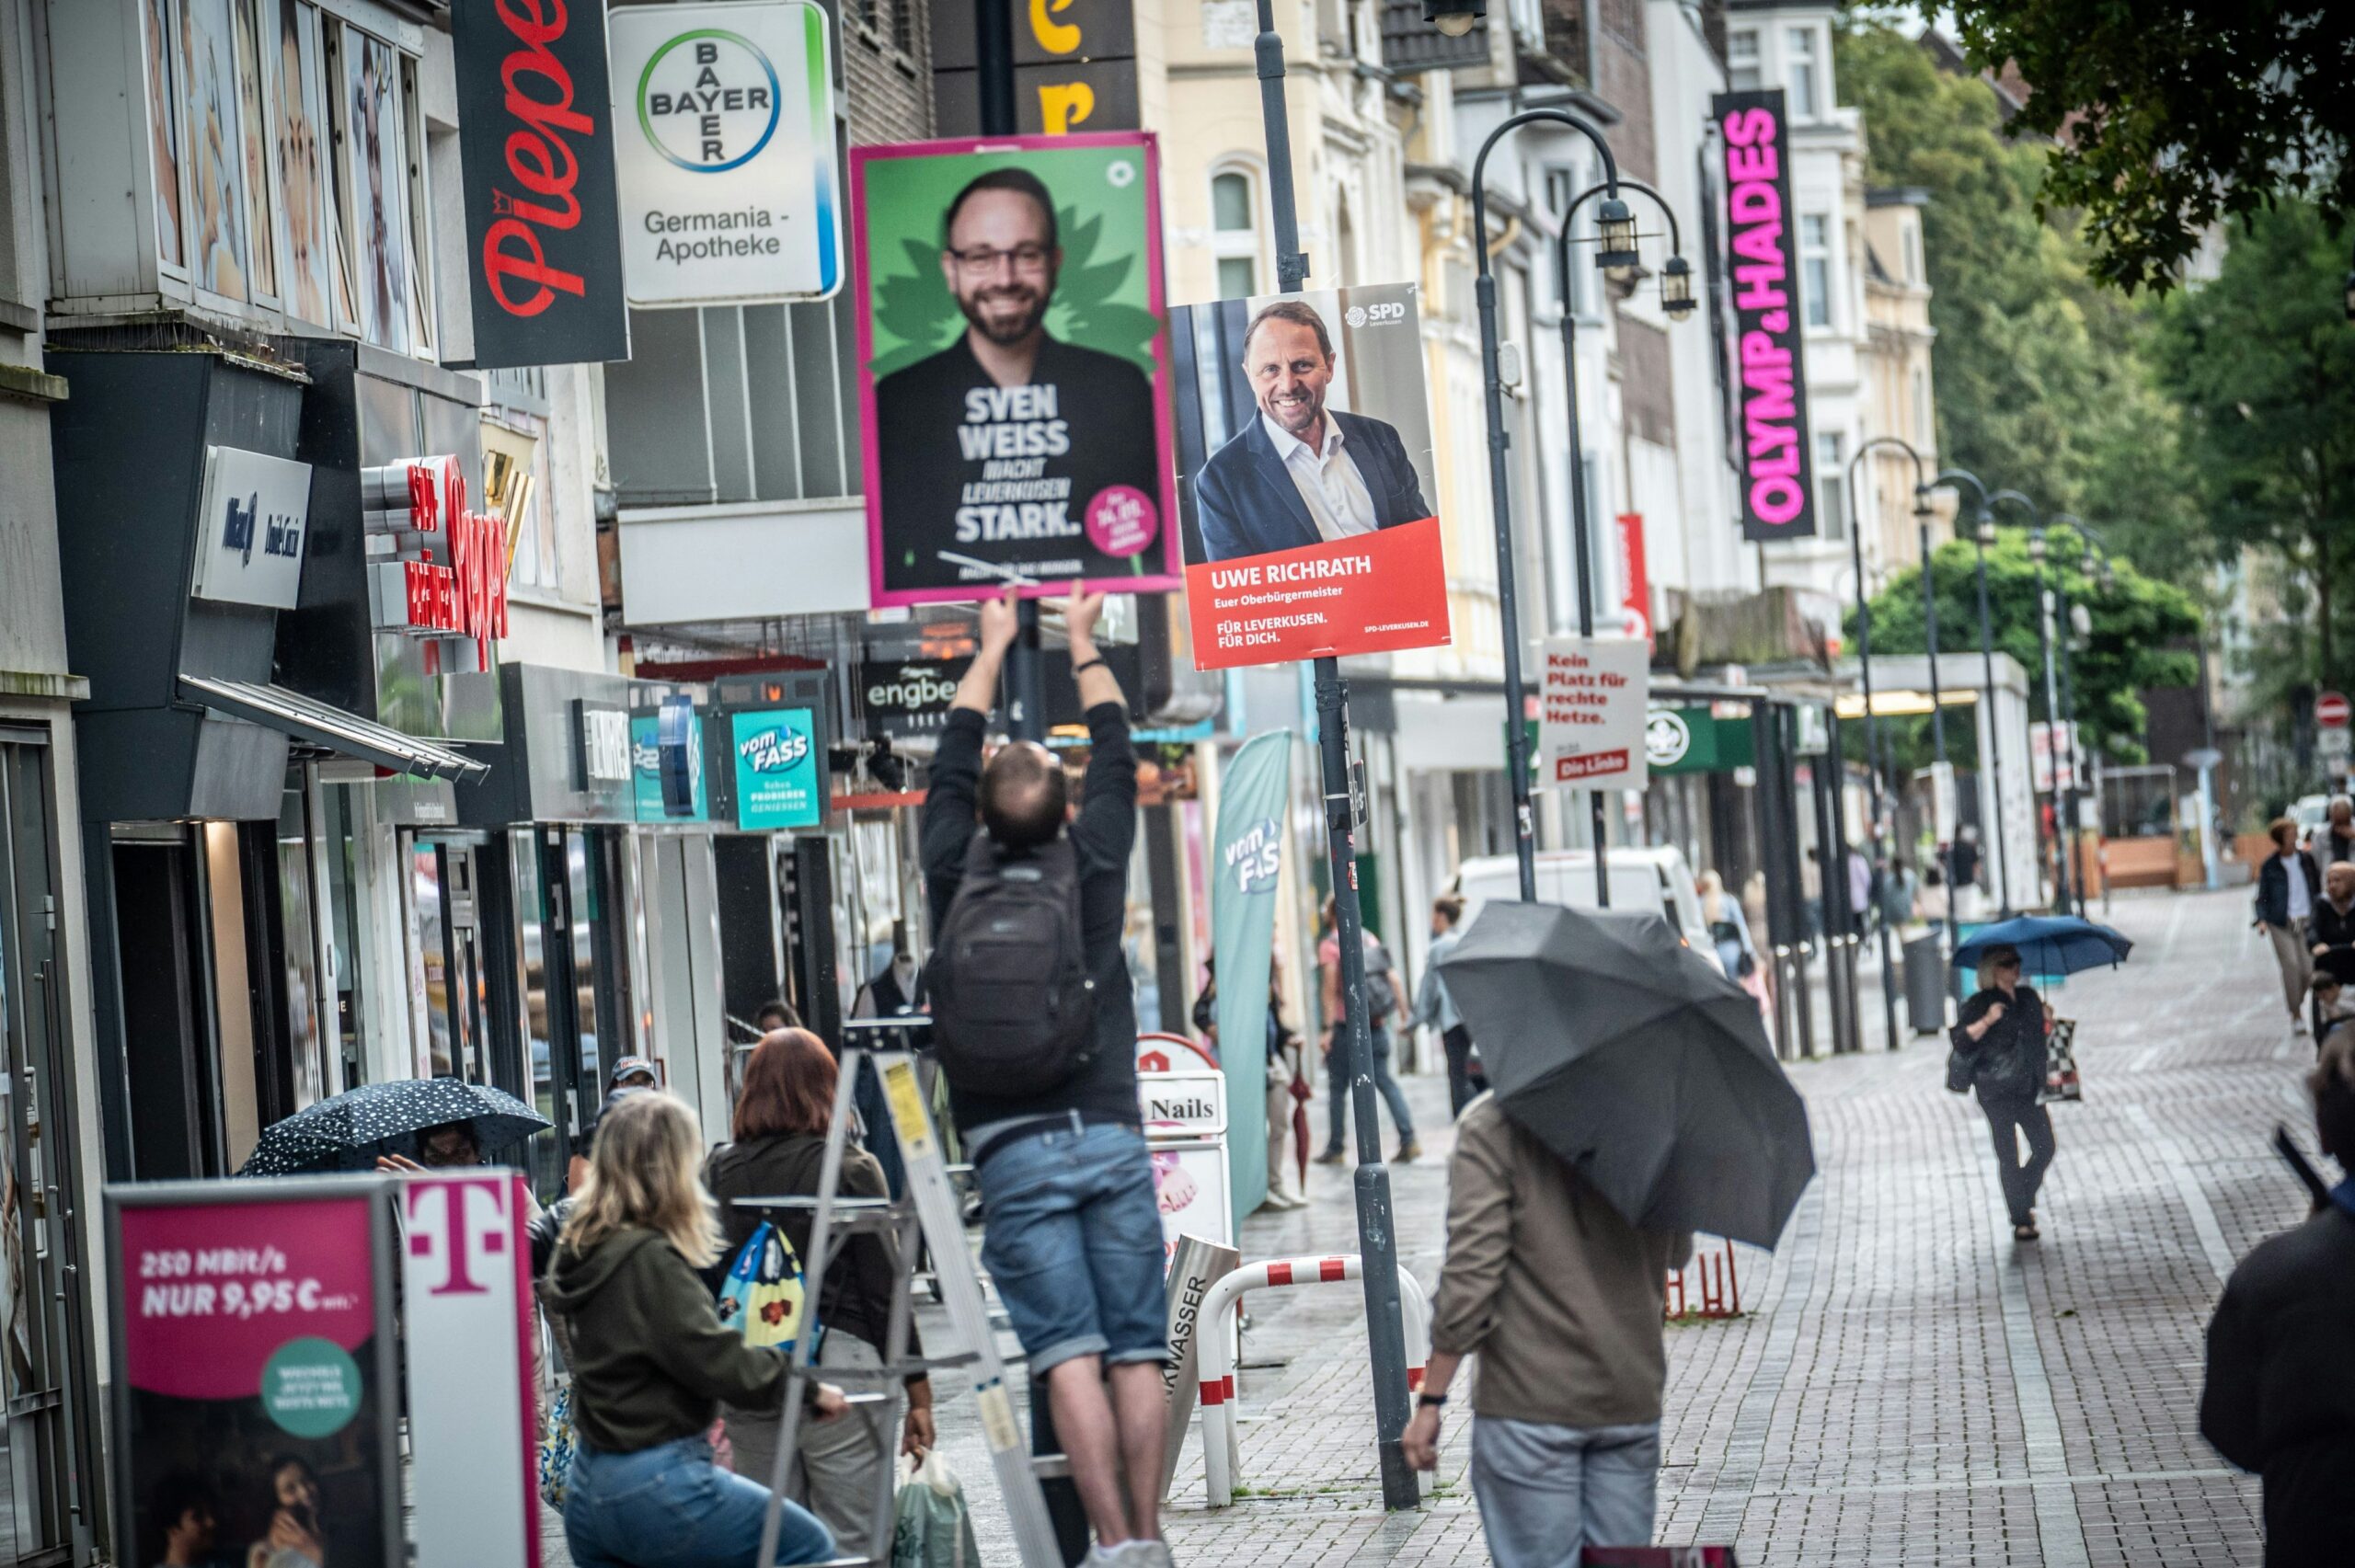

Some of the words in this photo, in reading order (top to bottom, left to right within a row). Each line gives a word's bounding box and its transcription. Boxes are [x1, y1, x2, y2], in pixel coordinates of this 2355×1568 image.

[649, 86, 770, 116] BAYER
[695, 42, 726, 162] BAYER
[644, 207, 771, 234] Germania
[655, 235, 780, 265] Apotheke
[1369, 302, 1405, 320] SPD
[965, 383, 1058, 423] SVEN
[958, 419, 1070, 459] WEISS
[955, 502, 1083, 543] STARK.
[1211, 567, 1261, 589] UWE
[1267, 555, 1372, 583] RICHRATH
[1214, 598, 1238, 609] Euer
[1241, 587, 1343, 606] Oberbürgermeister
[1217, 621, 1241, 635] FÜR
[1245, 612, 1327, 632] LEVERKUSEN.
[1364, 621, 1429, 633] SPD-LEVERKUSEN.DE
[1218, 634, 1244, 648] FÜR
[1246, 633, 1281, 645] DICH.
[1548, 654, 1589, 667] Kein
[1547, 673, 1594, 686] Platz
[1599, 672, 1626, 687] für
[867, 677, 957, 709] engbe
[1547, 692, 1607, 705] rechte
[1547, 711, 1605, 724] Hetze.
[740, 732, 775, 755] vom
[754, 736, 808, 772] FASS
[1560, 761, 1584, 777] Die
[1585, 756, 1625, 773] Linke
[1150, 1099, 1213, 1120] Nails
[141, 1250, 192, 1277] 250
[142, 1283, 216, 1317] NUR
